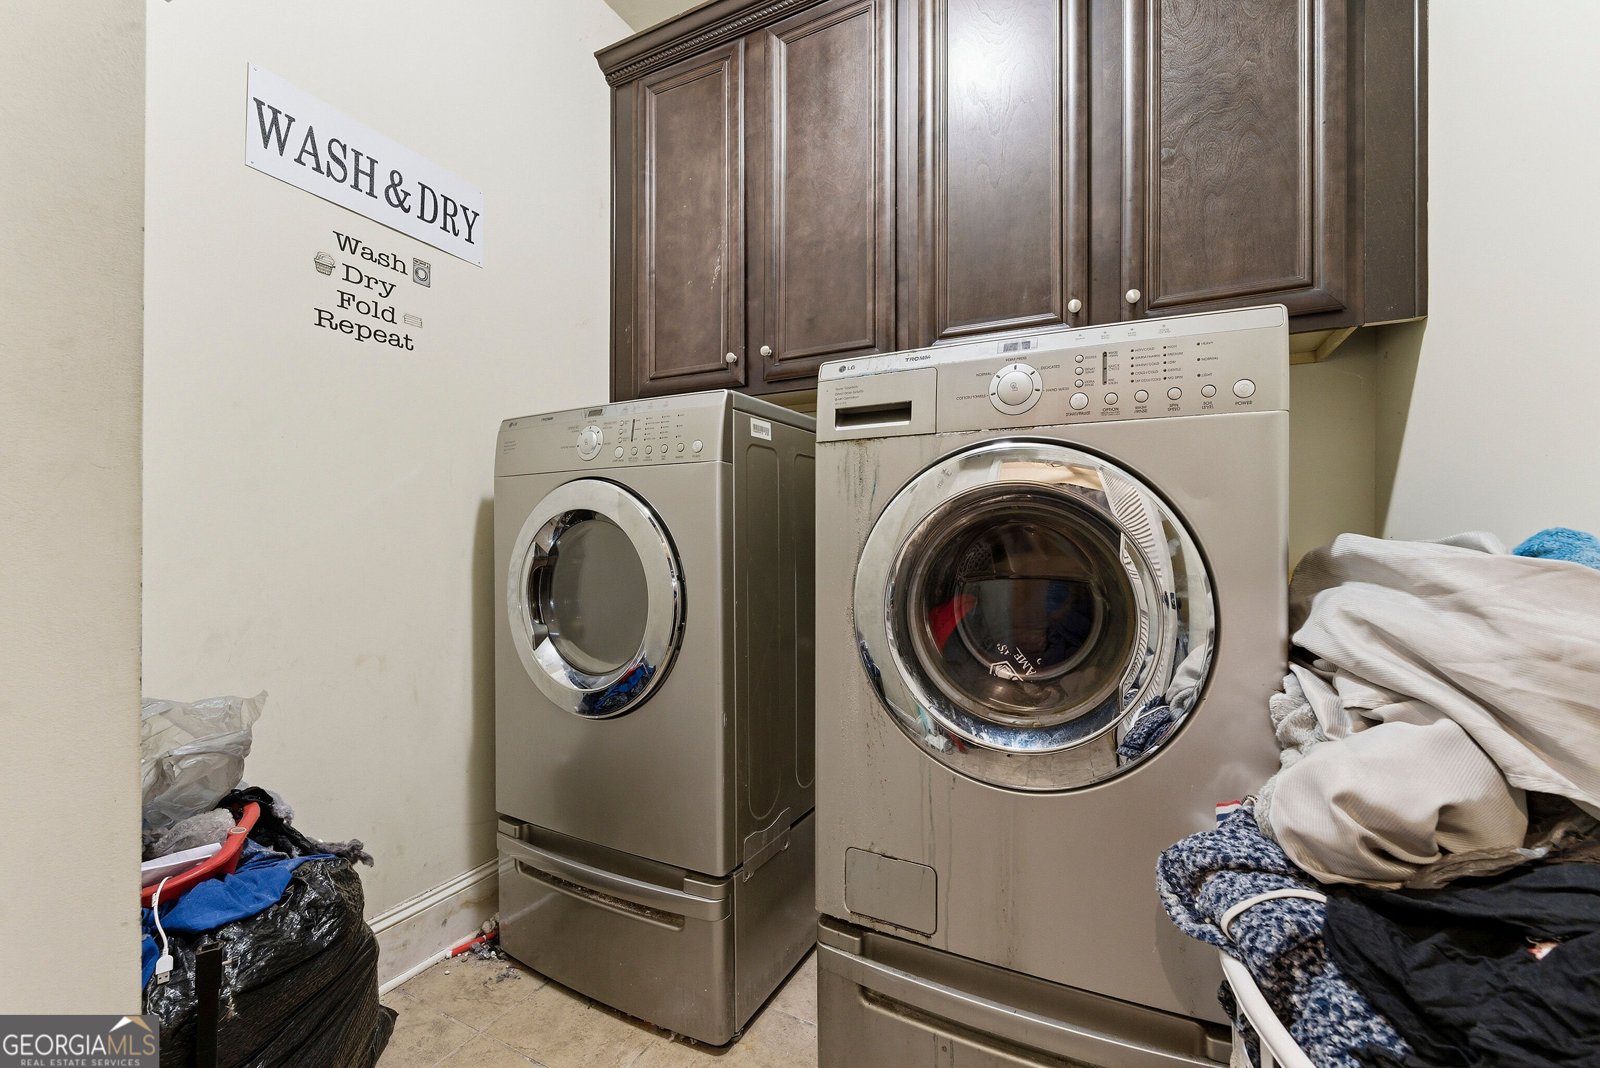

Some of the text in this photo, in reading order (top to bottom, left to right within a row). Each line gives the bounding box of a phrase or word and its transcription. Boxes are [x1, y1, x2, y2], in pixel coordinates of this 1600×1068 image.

[253, 97, 480, 244] WASH & DRY
[333, 231, 408, 275] Wash
[342, 263, 397, 298] Dry
[337, 290, 398, 325] Fold
[314, 308, 414, 350] Repeat
[905, 354, 931, 362] TROMM
